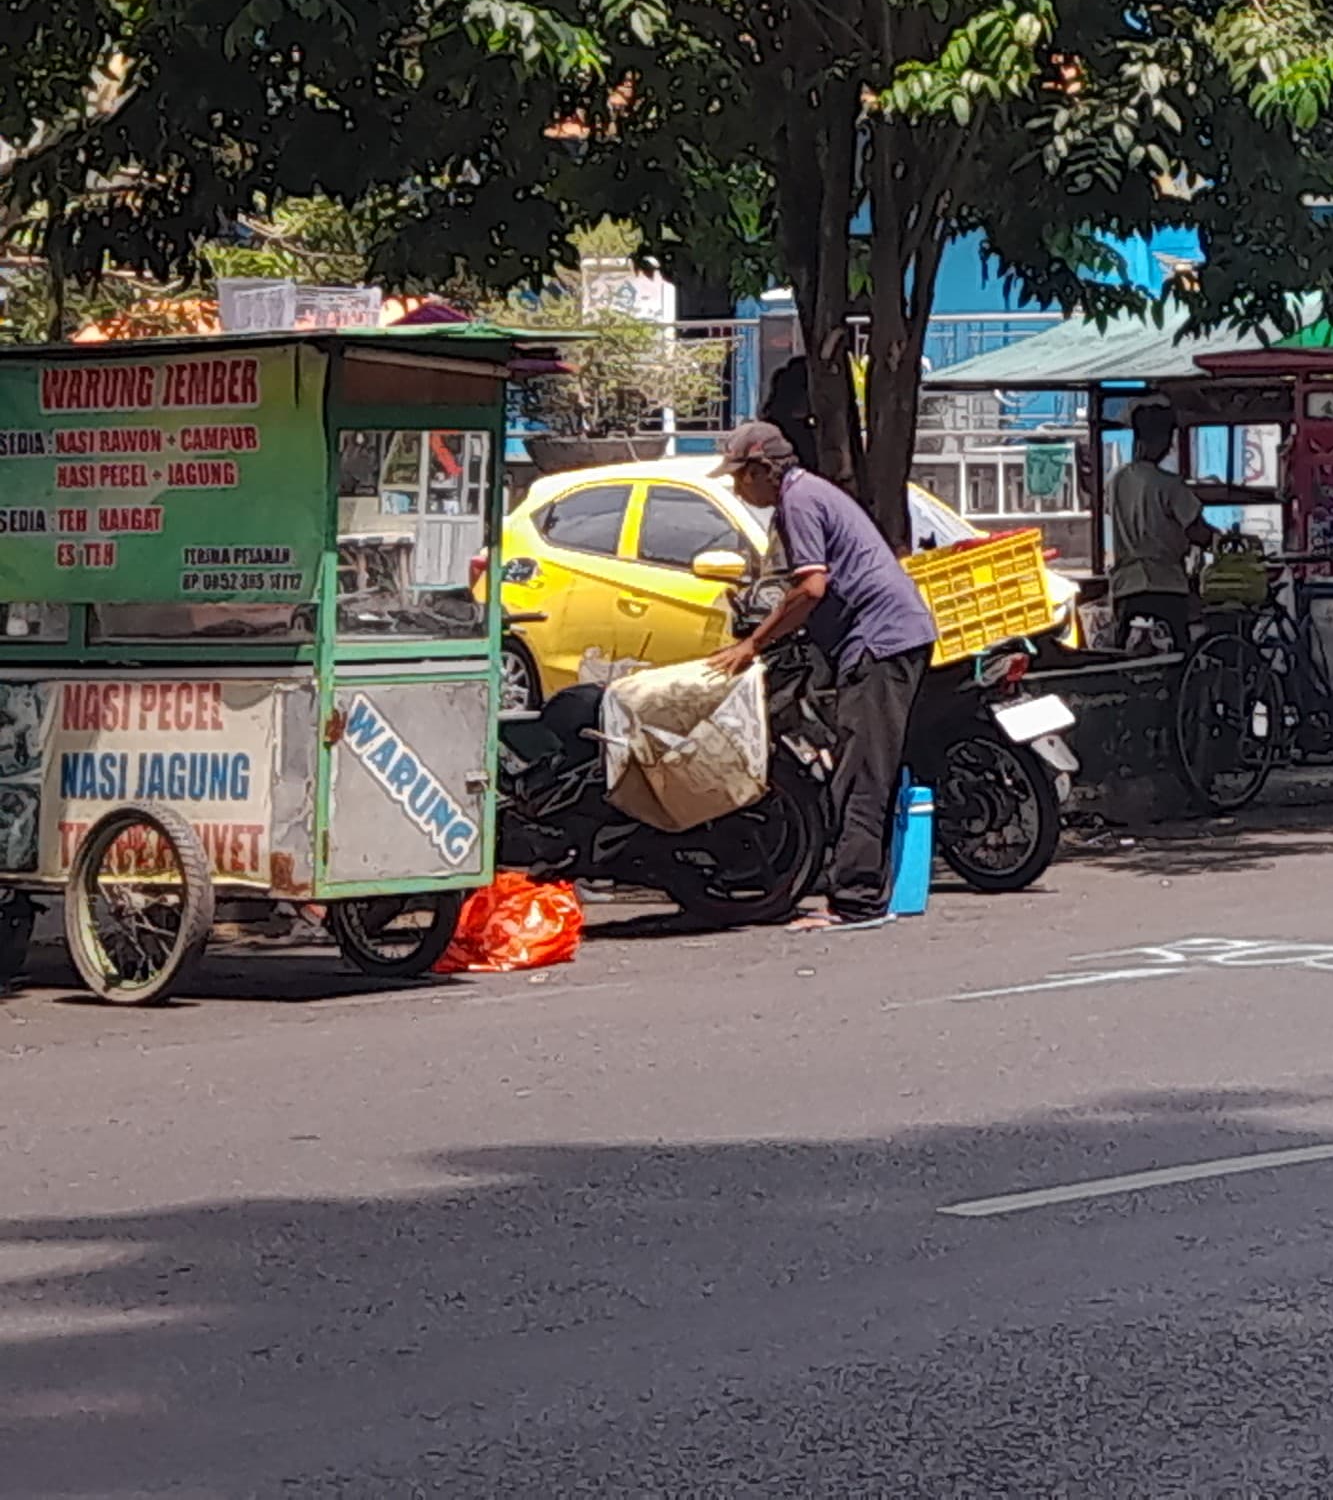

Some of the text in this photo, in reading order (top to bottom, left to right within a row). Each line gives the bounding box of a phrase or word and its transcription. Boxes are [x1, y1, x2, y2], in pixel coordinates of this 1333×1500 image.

[42, 359, 258, 409] WARUNG JEMBER
[56, 429, 94, 452] NASI
[180, 425, 258, 451] CAMPUR
[57, 463, 95, 489] NASI
[99, 463, 148, 488] PECEL
[167, 461, 236, 487] JAGUNG
[58, 509, 87, 533] TEH
[99, 507, 162, 532] HANGAT
[57, 542, 115, 567] ES TEH
[62, 682, 223, 731] NASI PECEL
[60, 752, 250, 801] NASI JAGUNG
[346, 698, 474, 859] WARUNG
